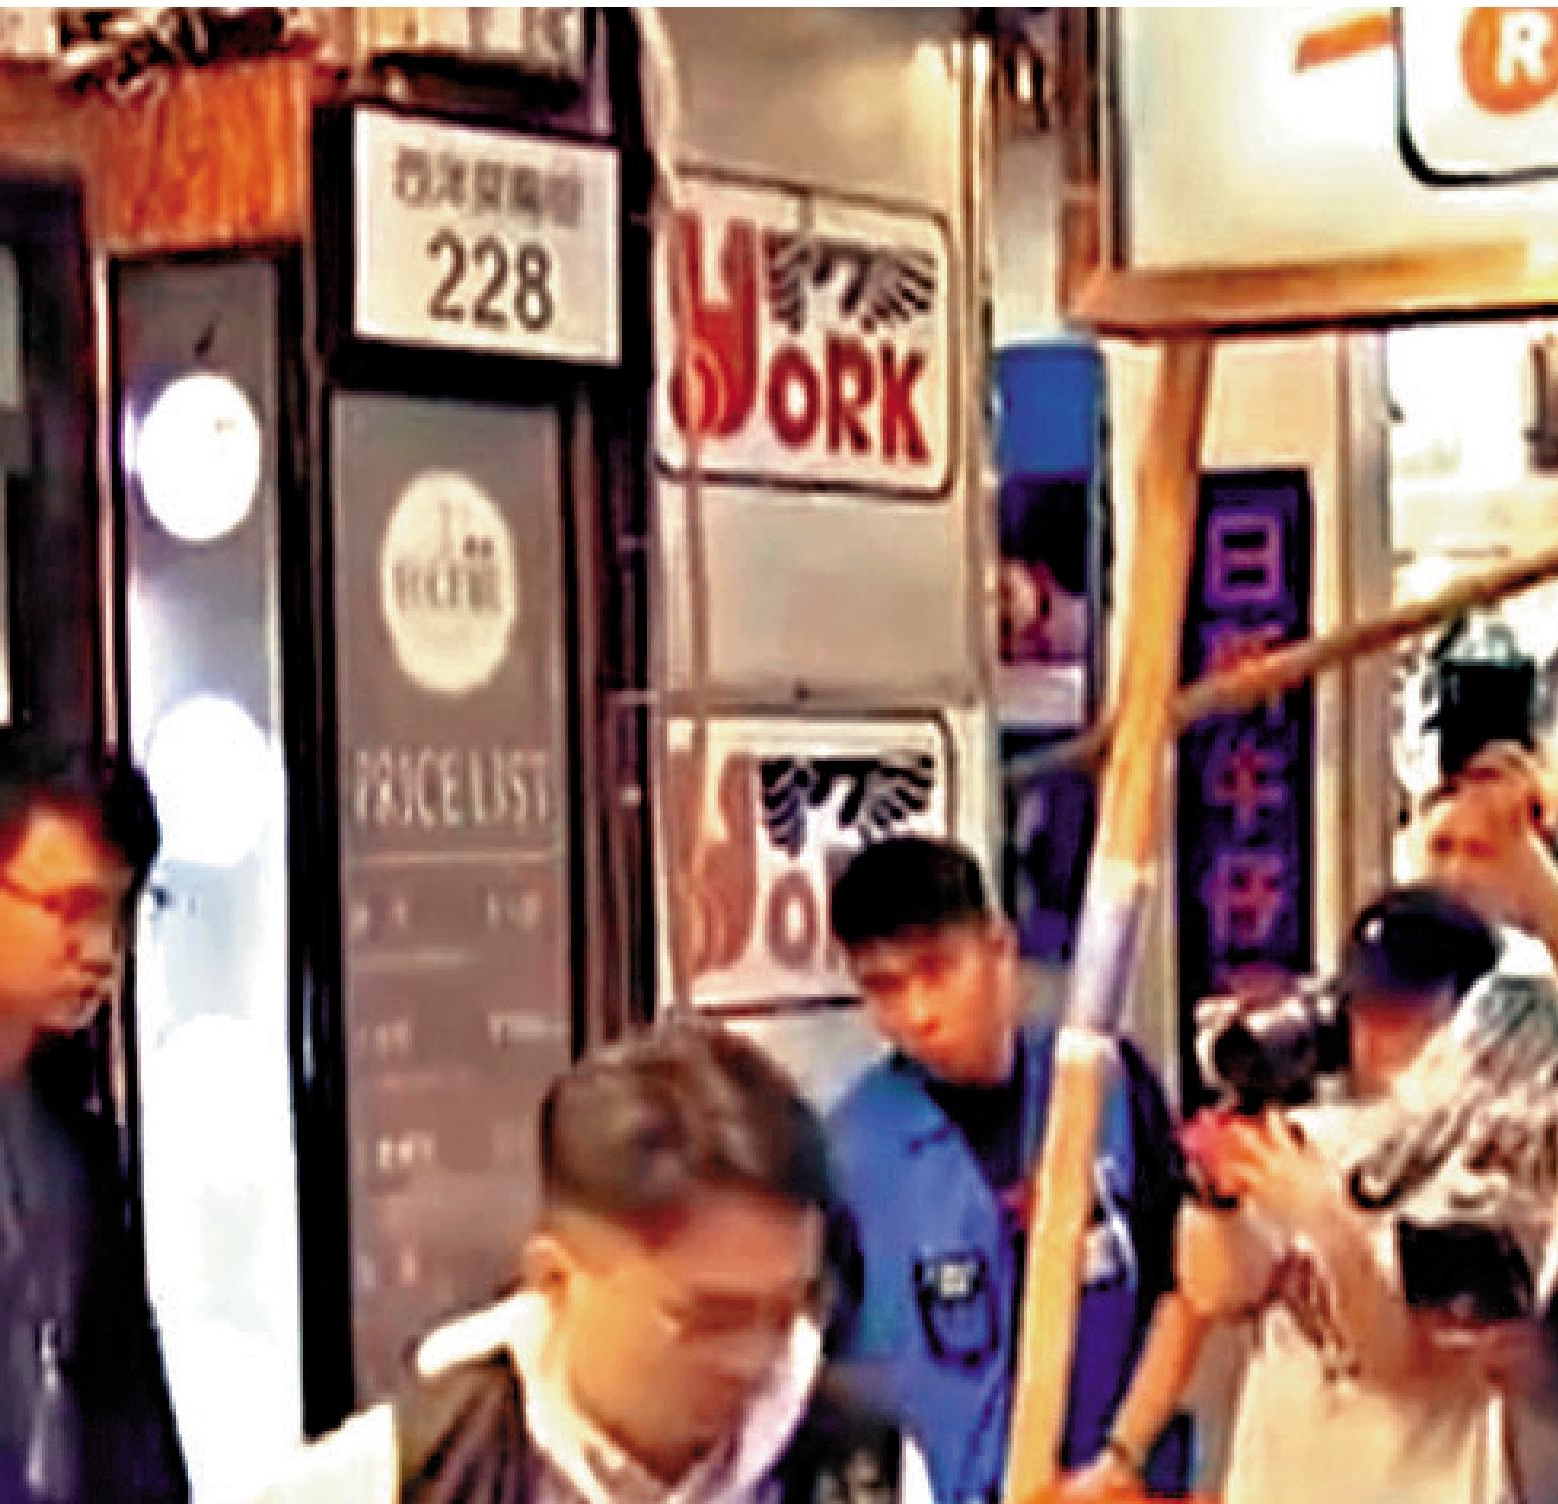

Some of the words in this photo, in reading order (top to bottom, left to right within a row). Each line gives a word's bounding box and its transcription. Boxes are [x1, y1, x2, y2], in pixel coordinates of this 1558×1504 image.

[427, 226, 554, 333] 228
[1206, 505, 1288, 1000] 日牛仔
